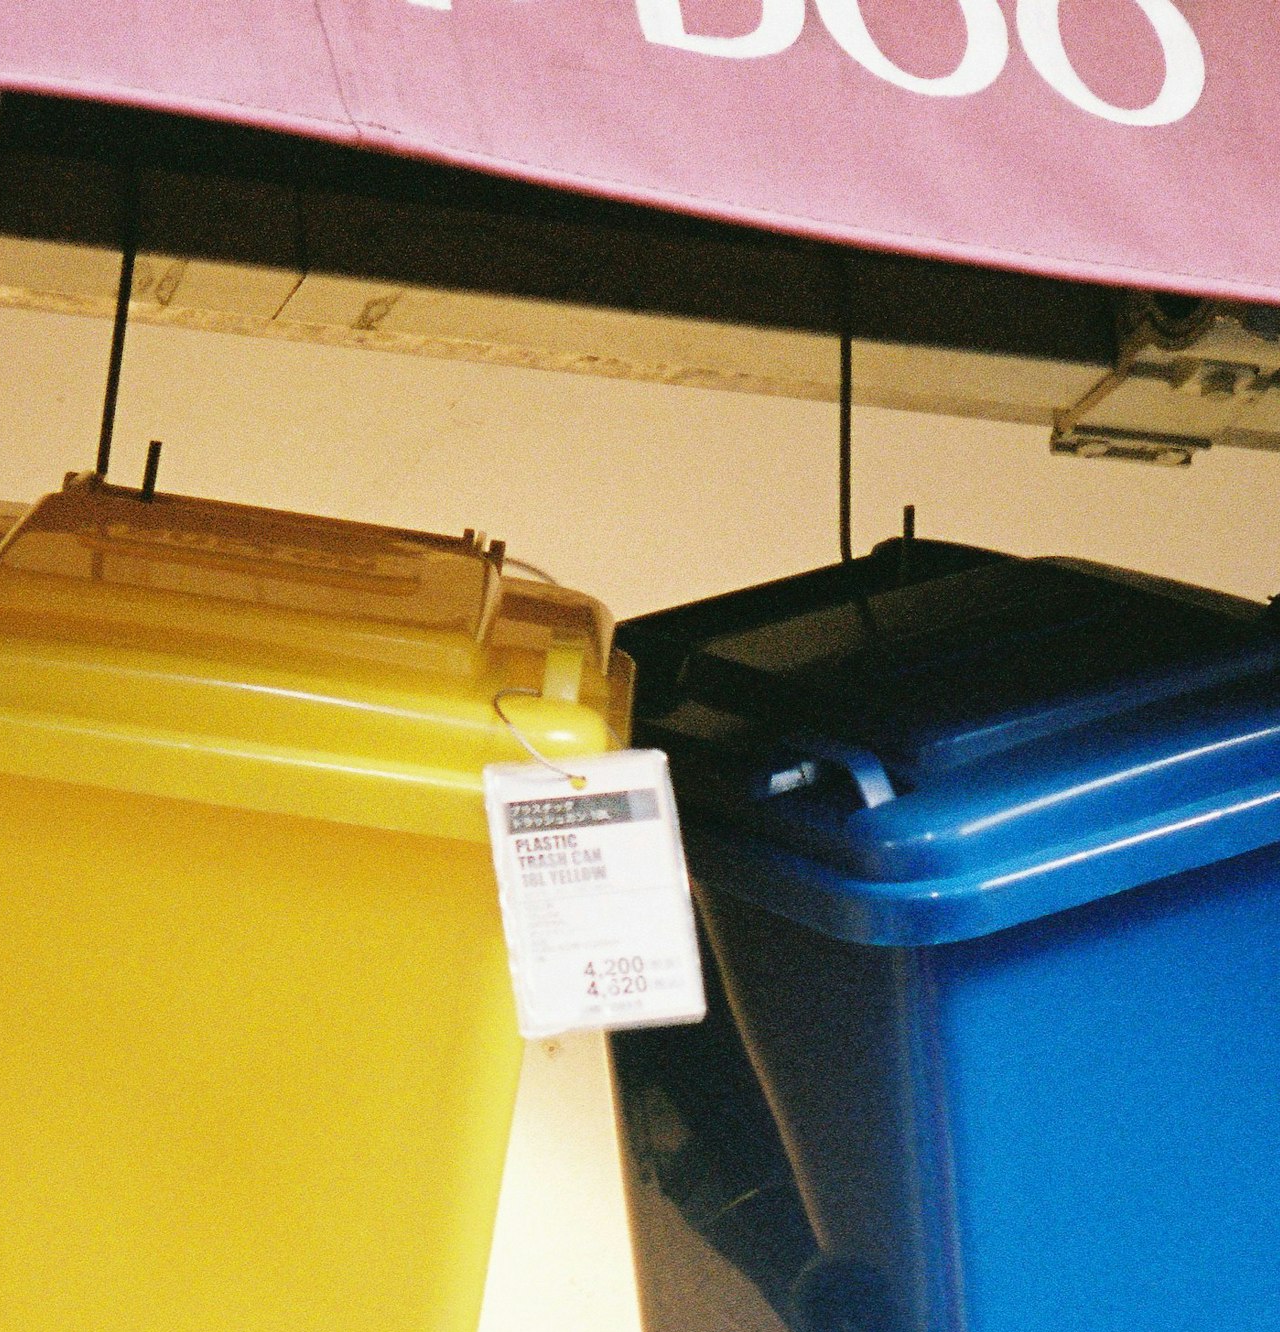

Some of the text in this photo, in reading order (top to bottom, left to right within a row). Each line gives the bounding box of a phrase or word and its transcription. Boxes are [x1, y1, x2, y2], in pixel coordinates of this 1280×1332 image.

[515, 833, 578, 852] PLASTIC
[518, 848, 602, 870] TRASH CAN
[549, 865, 608, 885] YELLOW
